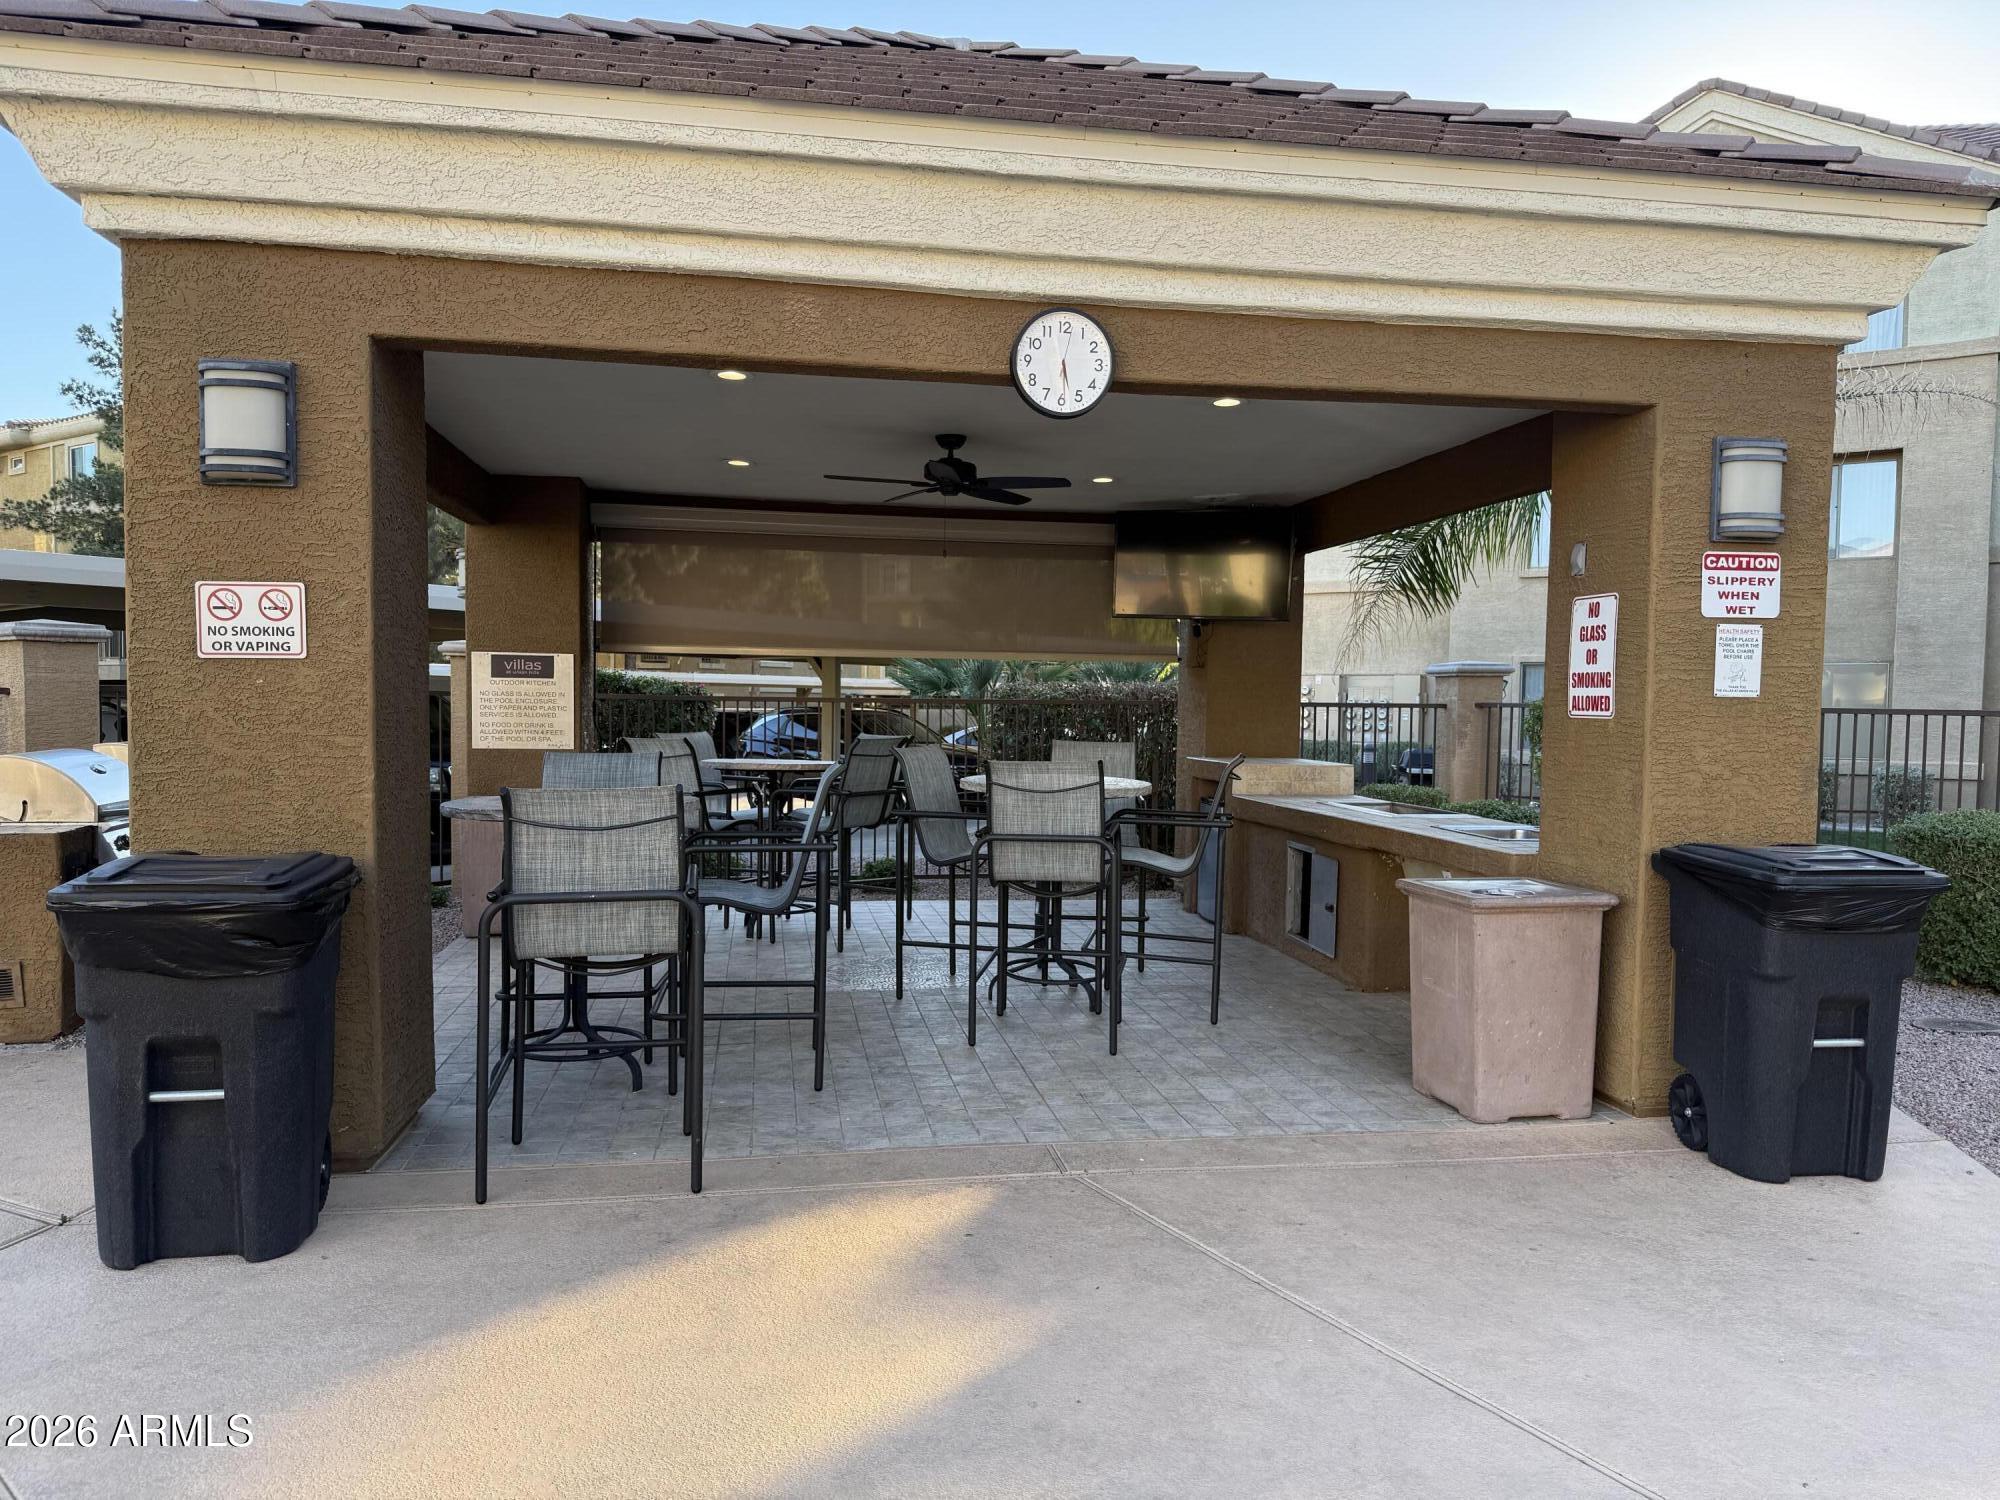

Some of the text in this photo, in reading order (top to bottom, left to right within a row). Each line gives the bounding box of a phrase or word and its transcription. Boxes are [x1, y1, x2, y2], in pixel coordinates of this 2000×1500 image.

[1042, 325, 1052, 338] 11
[1059, 321, 1072, 334] 12
[1081, 327, 1085, 340] 1
[1028, 337, 1042, 350] 10
[1089, 341, 1098, 353] 2
[1024, 354, 1032, 367] 9
[1094, 358, 1103, 372] 3
[1028, 373, 1036, 386] 8
[1088, 378, 1096, 390] 4
[1042, 388, 1051, 400] 7
[1057, 393, 1065, 406] 6
[1074, 390, 1083, 402] 5
[1706, 556, 1778, 569] CAUTION
[1707, 575, 1776, 586] SLIPPERY
[1718, 590, 1760, 600] WHEN
[1588, 601, 1600, 618] NO
[1725, 605, 1756, 615] WET
[207, 625, 295, 637] NO SMOKING
[1580, 624, 1607, 642] GLASS
[211, 641, 291, 652] OR VAPING
[1586, 649, 1598, 665] OR
[504, 659, 542, 671] villas
[1571, 671, 1612, 689] SMOKING
[1571, 695, 1611, 711] ALLOWED
